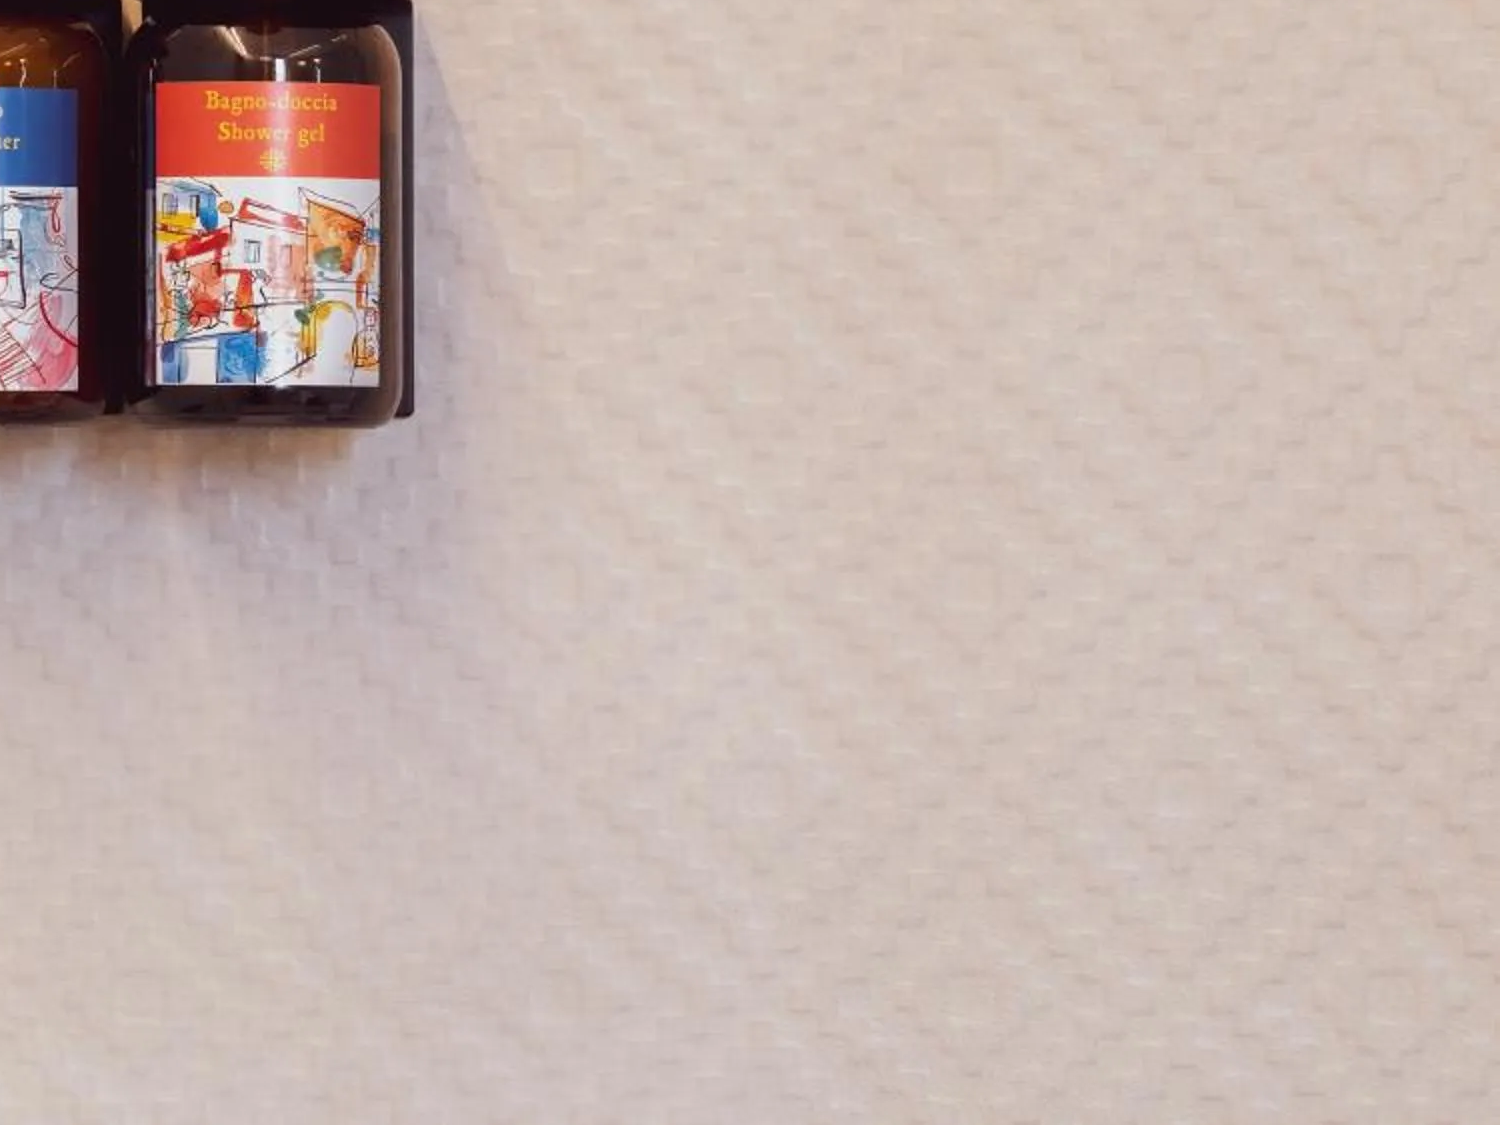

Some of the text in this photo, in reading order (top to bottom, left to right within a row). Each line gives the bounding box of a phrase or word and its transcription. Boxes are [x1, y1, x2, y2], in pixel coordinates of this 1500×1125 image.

[205, 90, 338, 116] Bagno-doccia
[218, 121, 325, 147] Shower gel
